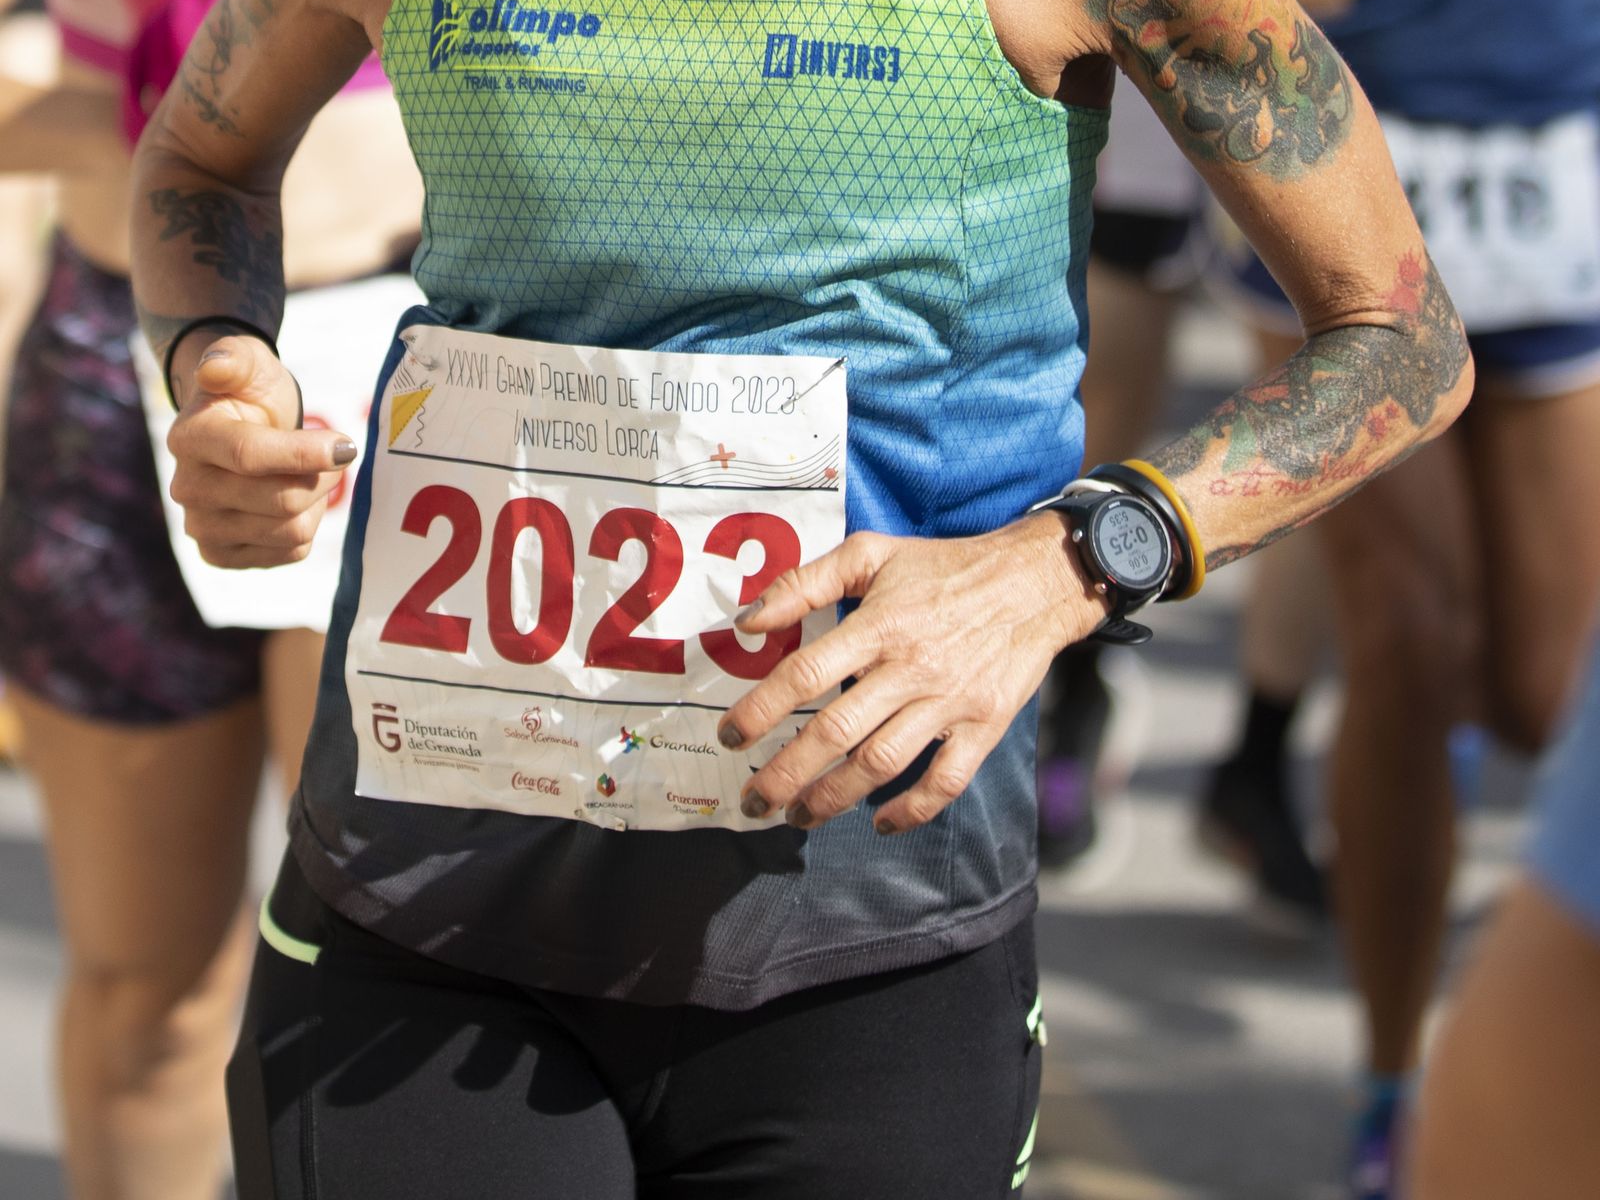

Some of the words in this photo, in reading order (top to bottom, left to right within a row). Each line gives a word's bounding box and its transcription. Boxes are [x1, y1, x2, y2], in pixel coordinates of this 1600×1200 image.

[461, 38, 541, 59] deportes
[464, 76, 501, 90] TRAIL
[504, 77, 515, 90] &
[517, 77, 587, 93] RUNNING
[445, 347, 488, 391] XXXVI
[496, 355, 535, 398] GRAN
[539, 362, 608, 407] PREMIO
[617, 376, 641, 410] DE
[650, 371, 719, 414] FONDO
[731, 375, 796, 415] 2023
[514, 408, 598, 453] UNIVERSO
[605, 418, 660, 461] LORCA
[1109, 525, 1149, 556] 0:25
[379, 484, 803, 681] 2023
[404, 718, 479, 742] Diputación
[407, 737, 424, 751] de
[424, 739, 483, 758] Granada
[649, 733, 719, 757] Granada
[666, 791, 720, 807] Cruzcampo
